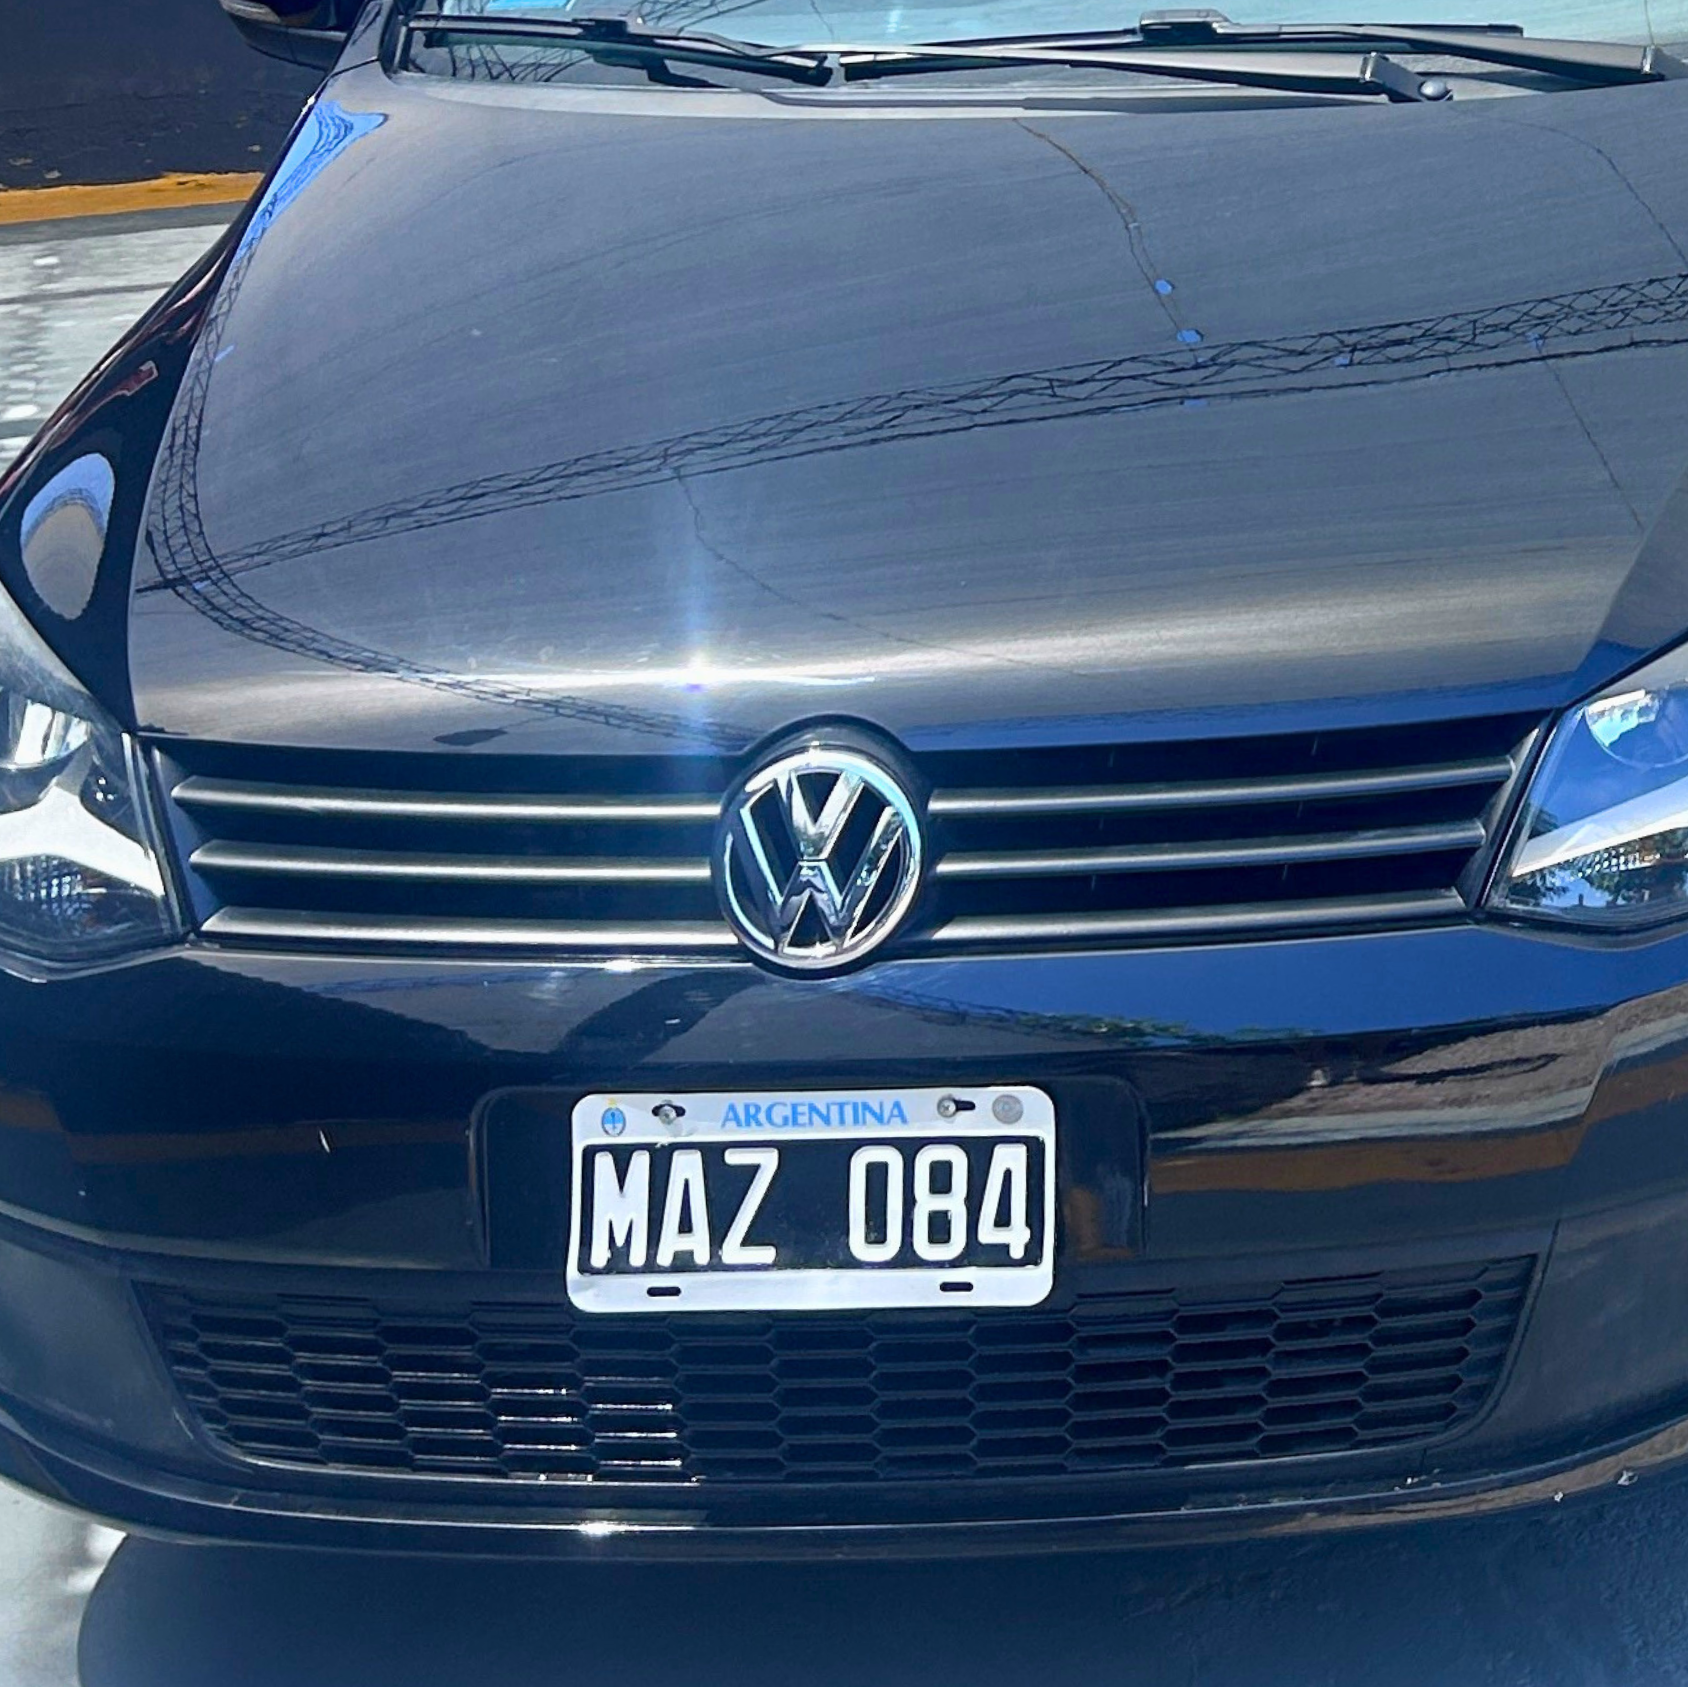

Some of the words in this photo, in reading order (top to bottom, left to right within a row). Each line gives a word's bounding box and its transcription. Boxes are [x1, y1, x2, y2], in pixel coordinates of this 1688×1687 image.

[720, 1099, 909, 1130] ARGENTINA
[589, 1146, 780, 1268] MAZ
[848, 1142, 1032, 1264] 084
